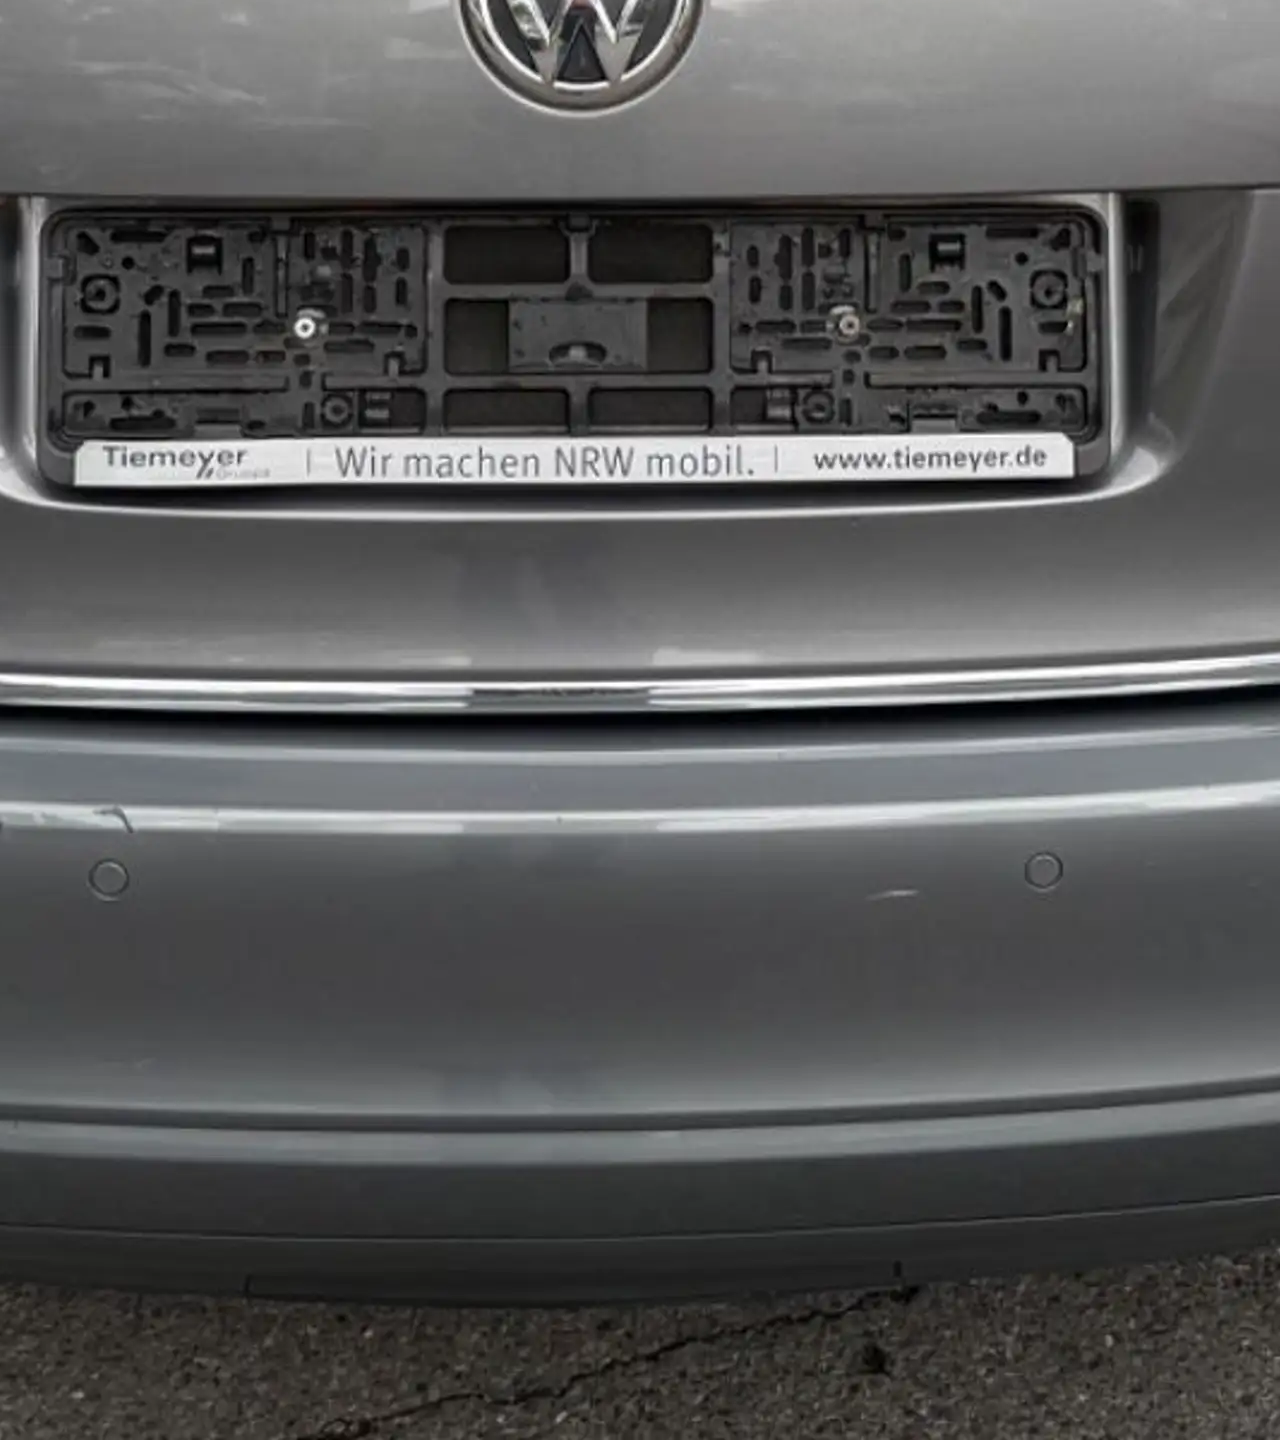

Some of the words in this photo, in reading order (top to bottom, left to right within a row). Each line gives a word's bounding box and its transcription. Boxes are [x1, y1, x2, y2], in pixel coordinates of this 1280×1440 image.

[103, 445, 248, 479] Tiemeyer
[335, 446, 392, 478] Wir
[403, 445, 541, 478] machen
[555, 446, 634, 478] NRW
[646, 445, 755, 477] mobil.
[814, 444, 1048, 472] www.tiemeyer.de
